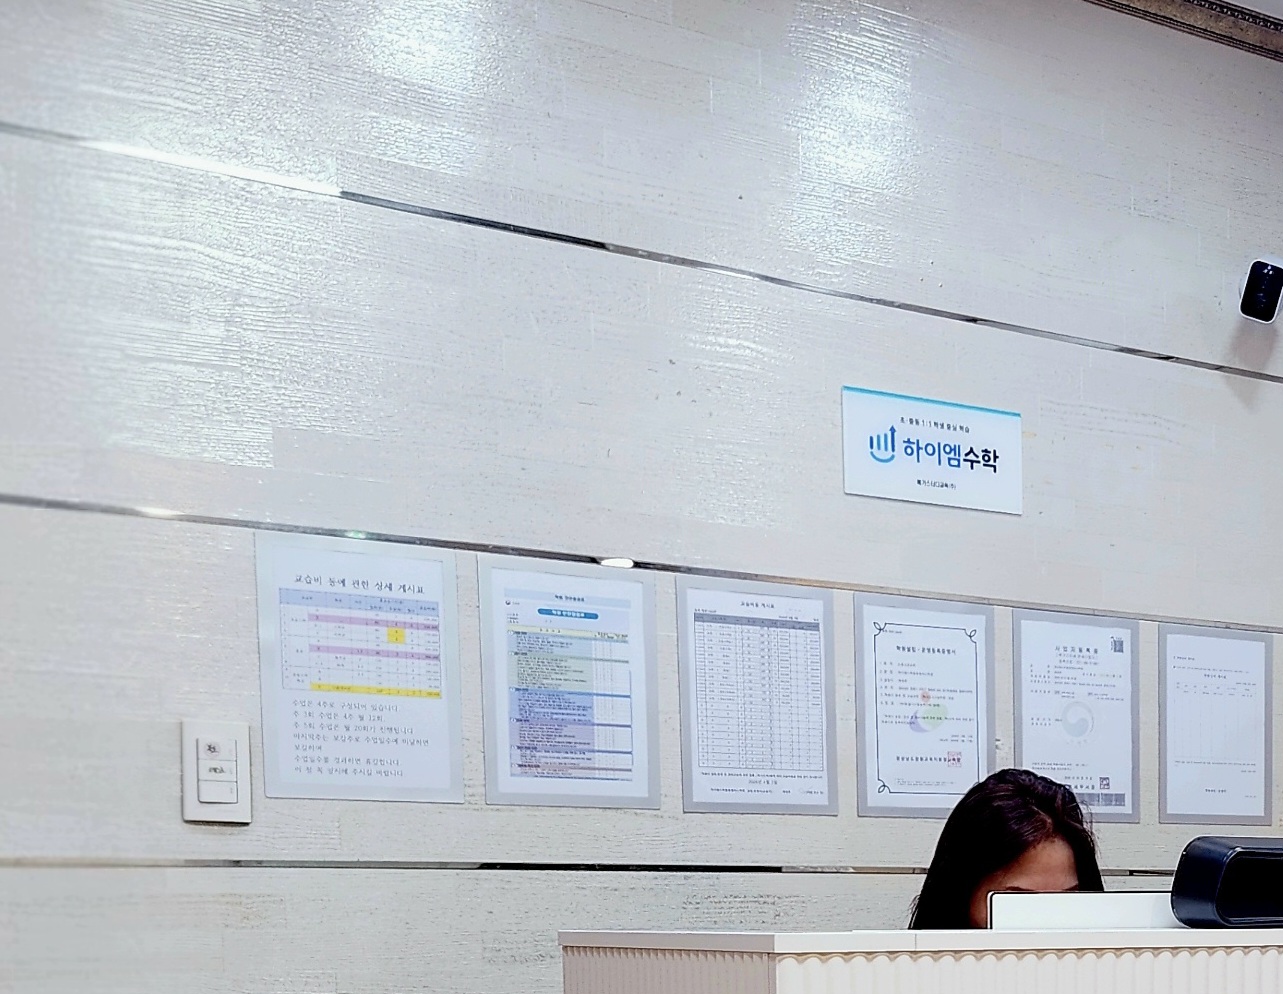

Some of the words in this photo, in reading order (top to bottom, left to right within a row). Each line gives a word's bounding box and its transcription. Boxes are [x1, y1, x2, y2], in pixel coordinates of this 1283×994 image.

[902, 437, 1000, 473] 하이엠수학
[295, 574, 322, 585] 교습비
[328, 576, 346, 587] 등에
[352, 579, 369, 589] 관한
[375, 581, 393, 591] 상세
[398, 583, 425, 594] 게시표
